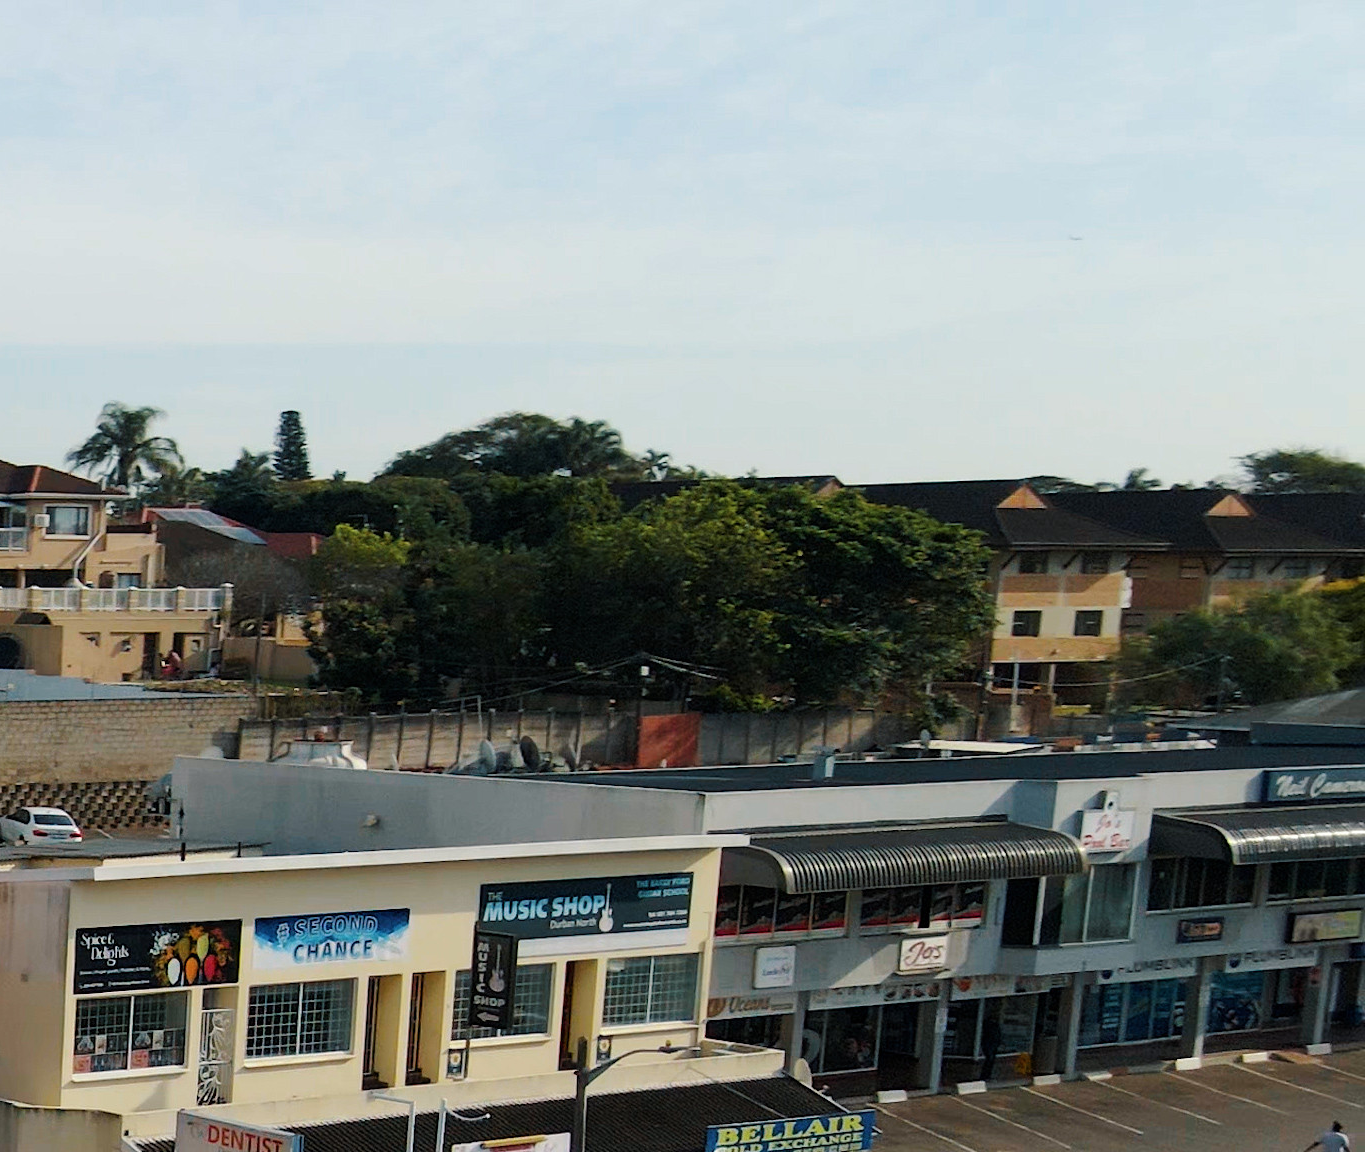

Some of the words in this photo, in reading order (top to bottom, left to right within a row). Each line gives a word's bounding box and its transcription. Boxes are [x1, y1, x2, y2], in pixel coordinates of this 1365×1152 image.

[483, 899, 549, 922] MUSIC
[551, 895, 605, 918] SHOP
[488, 892, 503, 901] THE
[294, 915, 378, 940] SECOND
[293, 939, 373, 964] CHANCE
[475, 942, 489, 993] MUSIC
[473, 994, 506, 1007] SHOP
[717, 1115, 864, 1146] BELLAIR
[768, 1132, 864, 1151] EXCHANGE
